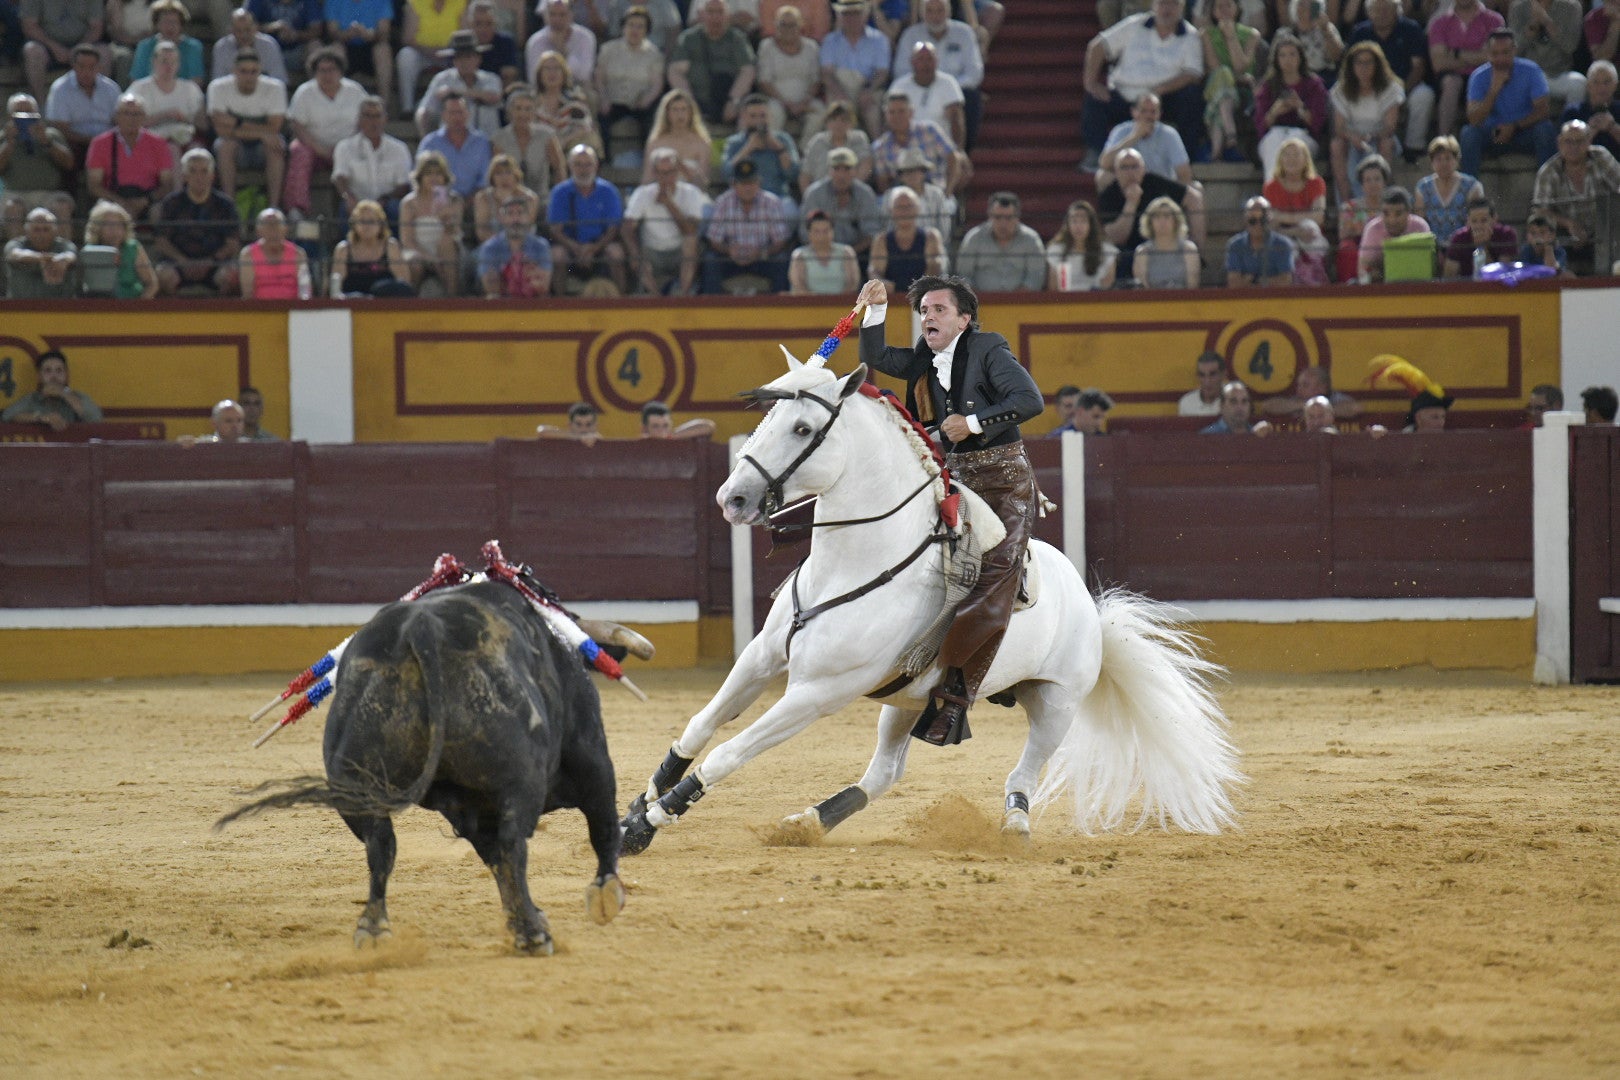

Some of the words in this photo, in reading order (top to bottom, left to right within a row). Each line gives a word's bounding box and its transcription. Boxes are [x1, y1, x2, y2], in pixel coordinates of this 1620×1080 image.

[0, 357, 16, 398] 4
[617, 347, 642, 387] 4
[1249, 341, 1274, 380] 4
